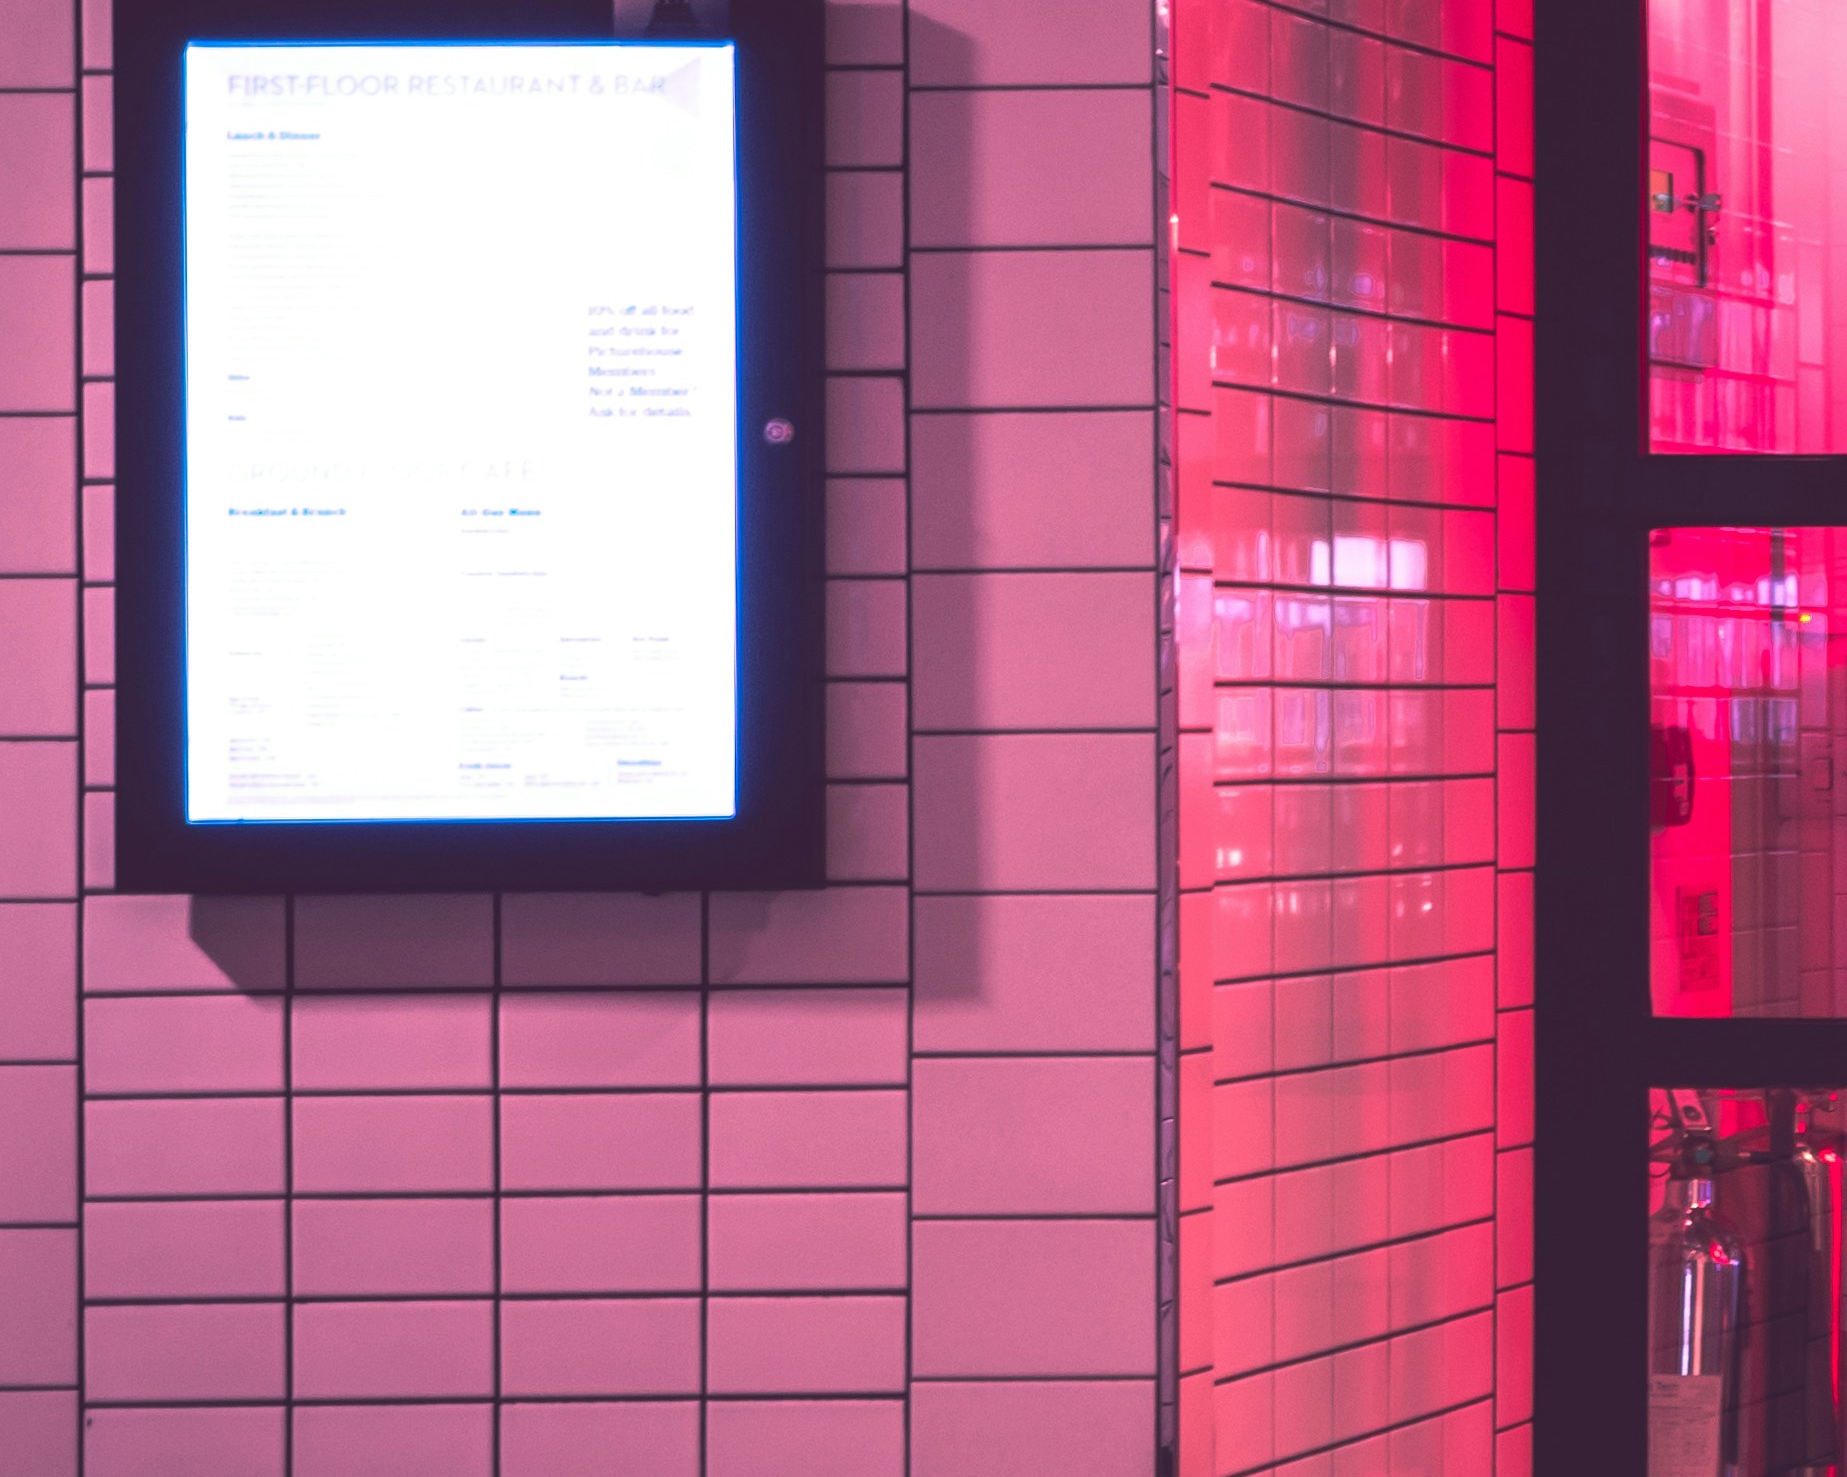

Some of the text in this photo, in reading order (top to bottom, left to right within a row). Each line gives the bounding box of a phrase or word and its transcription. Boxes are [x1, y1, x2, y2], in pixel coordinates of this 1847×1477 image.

[407, 74, 582, 96] RESTAURANT
[588, 74, 605, 96] &
[613, 74, 667, 96] BAR
